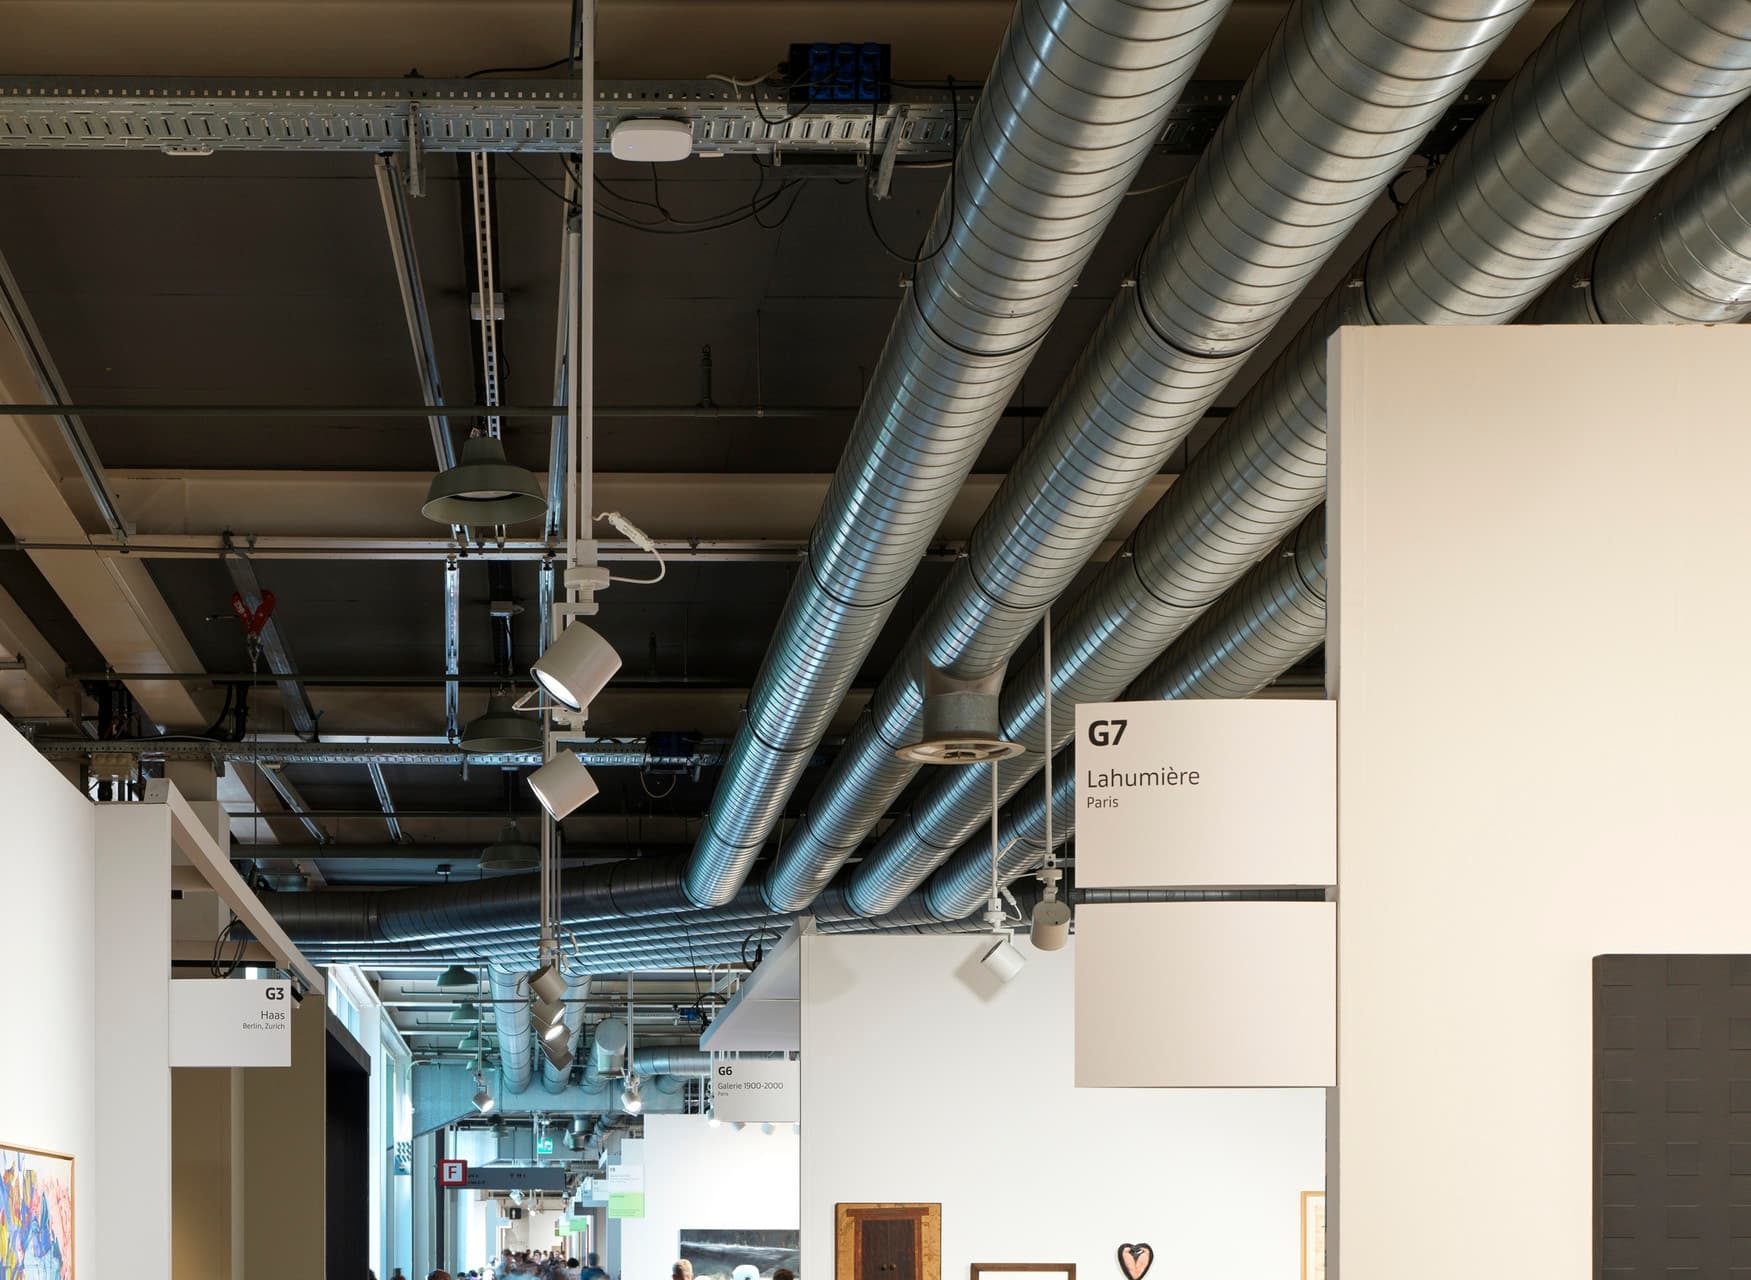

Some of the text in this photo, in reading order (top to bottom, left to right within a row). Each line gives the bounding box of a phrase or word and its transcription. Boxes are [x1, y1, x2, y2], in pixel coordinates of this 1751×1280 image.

[1088, 720, 1128, 746] G7
[1087, 766, 1200, 788] Lahumière
[1087, 796, 1119, 808] Paris
[265, 987, 285, 1000] G3
[261, 1010, 285, 1020] Haas
[242, 1022, 285, 1031] Berlin, Zurich
[718, 1066, 733, 1076] G6
[717, 1081, 784, 1090] Galerie 1900-2000
[448, 1165, 457, 1179] F
